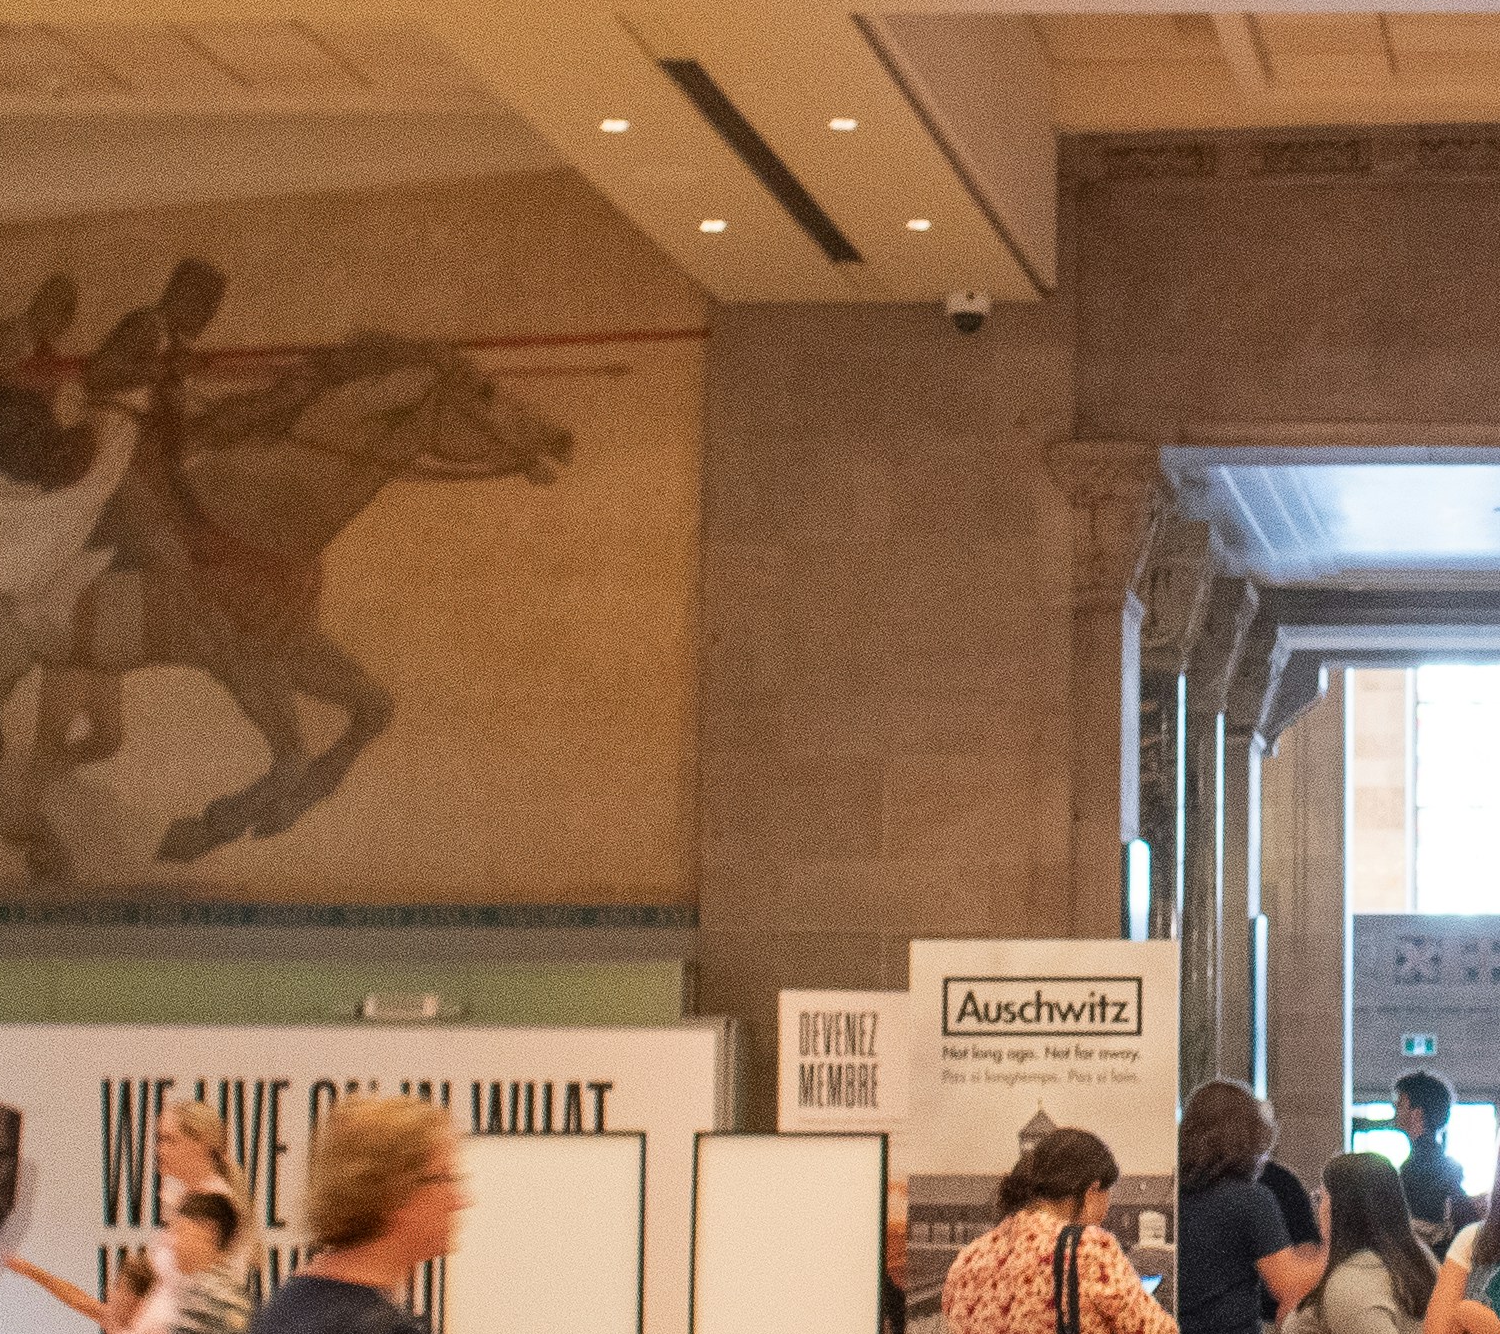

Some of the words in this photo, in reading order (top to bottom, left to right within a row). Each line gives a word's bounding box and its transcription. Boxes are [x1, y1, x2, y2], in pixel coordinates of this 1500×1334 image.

[956, 989, 1130, 1024] Auschwitz
[798, 1010, 879, 1058] DEVENEZ
[942, 1045, 970, 1060] Not
[972, 1044, 1004, 1064] long
[1007, 1048, 1038, 1064] ago.
[1045, 1045, 1070, 1059] Not
[1074, 1044, 1095, 1060] far
[1099, 1047, 1141, 1064] away.
[798, 1063, 879, 1108] MEMBRE
